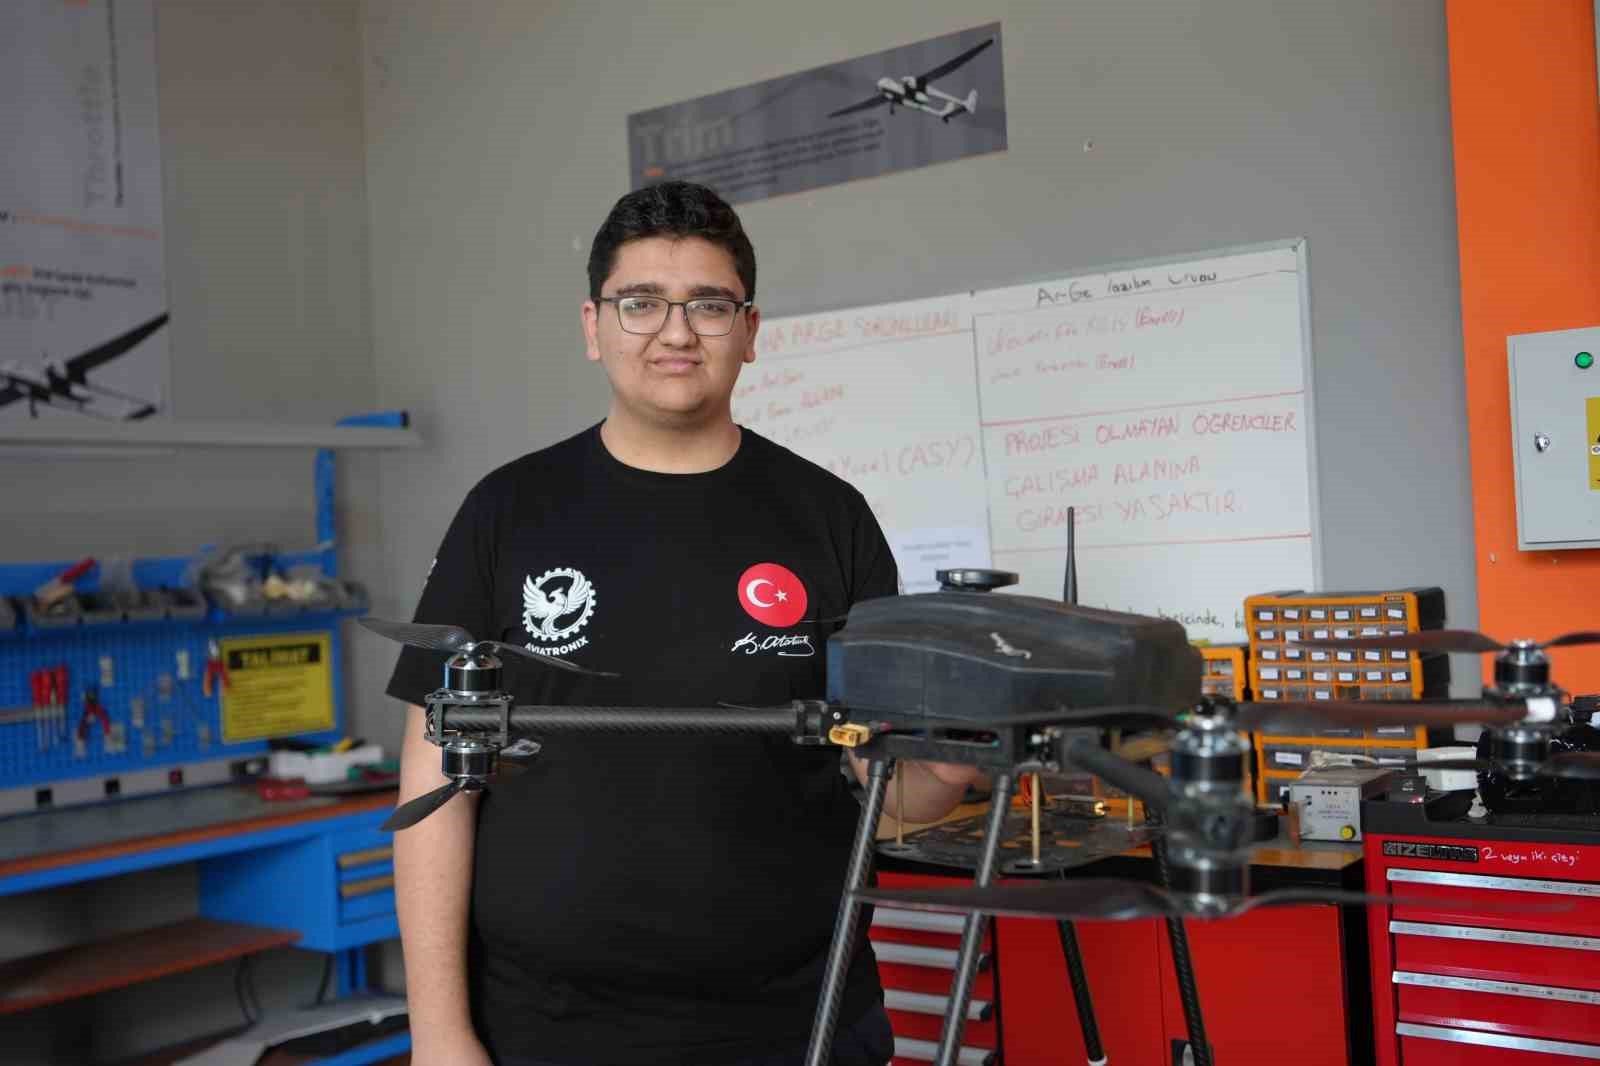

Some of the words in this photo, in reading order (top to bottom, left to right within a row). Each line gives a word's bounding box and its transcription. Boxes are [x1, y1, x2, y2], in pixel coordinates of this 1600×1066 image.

[1095, 413, 1179, 444] OLMAYAN
[524, 636, 589, 656] AVIATRONIX
[1481, 847, 1498, 860] 2
